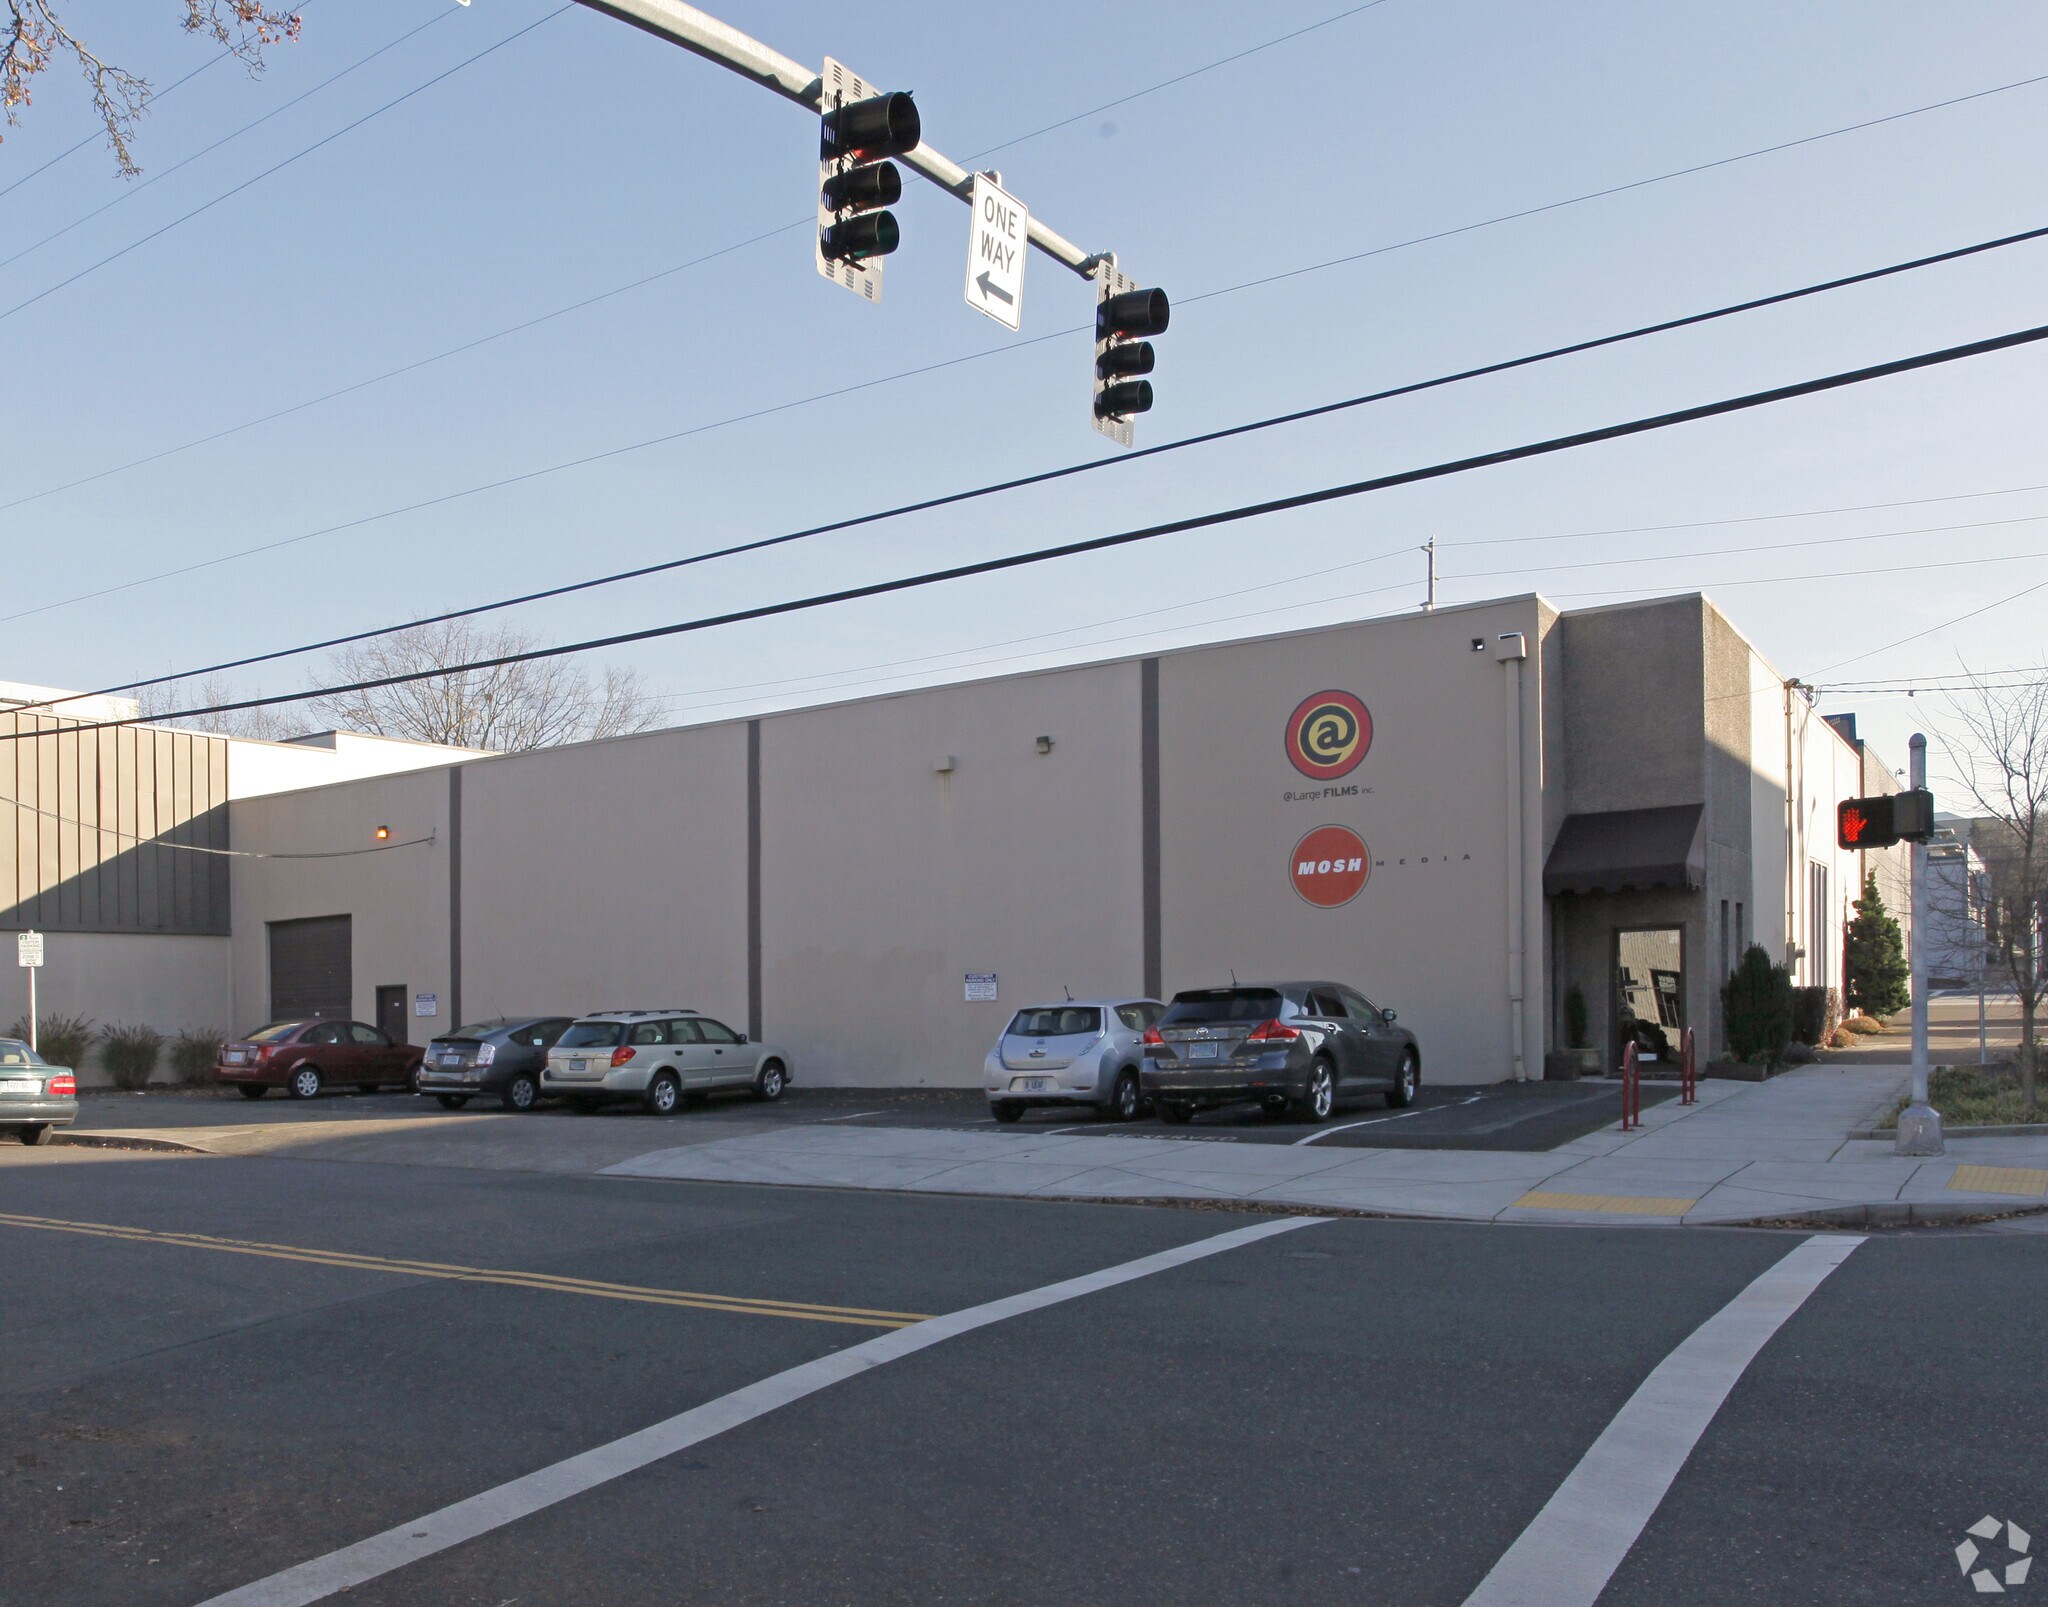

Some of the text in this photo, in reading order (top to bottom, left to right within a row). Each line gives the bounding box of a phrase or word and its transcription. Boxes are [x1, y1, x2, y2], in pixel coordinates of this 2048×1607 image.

[984, 195, 1017, 240] ONE
[981, 230, 1015, 274] WAY
[1299, 704, 1357, 765] @
[1283, 785, 1375, 802] @Large FILMS inc.
[1297, 853, 1471, 876] MOSH MEDIA
